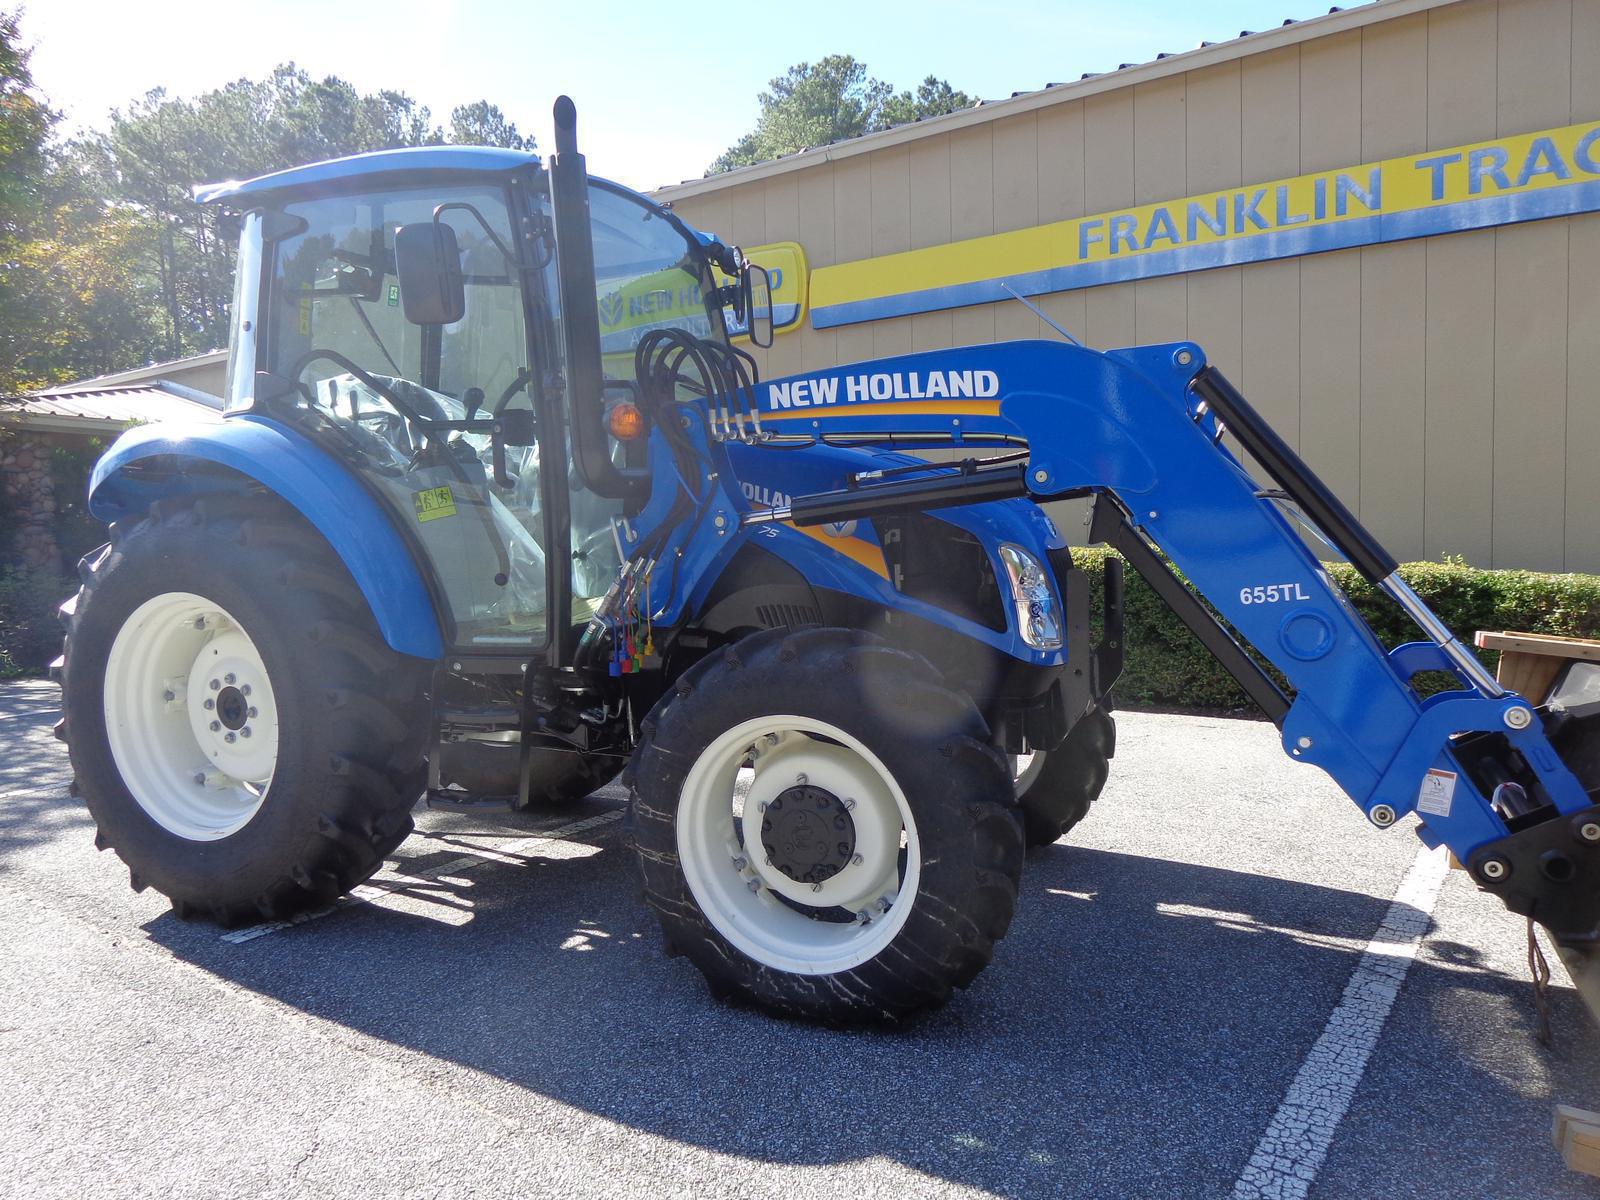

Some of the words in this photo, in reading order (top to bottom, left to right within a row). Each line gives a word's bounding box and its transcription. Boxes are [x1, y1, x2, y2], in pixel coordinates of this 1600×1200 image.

[1078, 166, 1382, 260] FRANKLIN
[768, 377, 839, 410] NEW
[846, 370, 999, 402] HOLLAND
[757, 526, 780, 538] 75
[1240, 583, 1310, 605] 655TL
